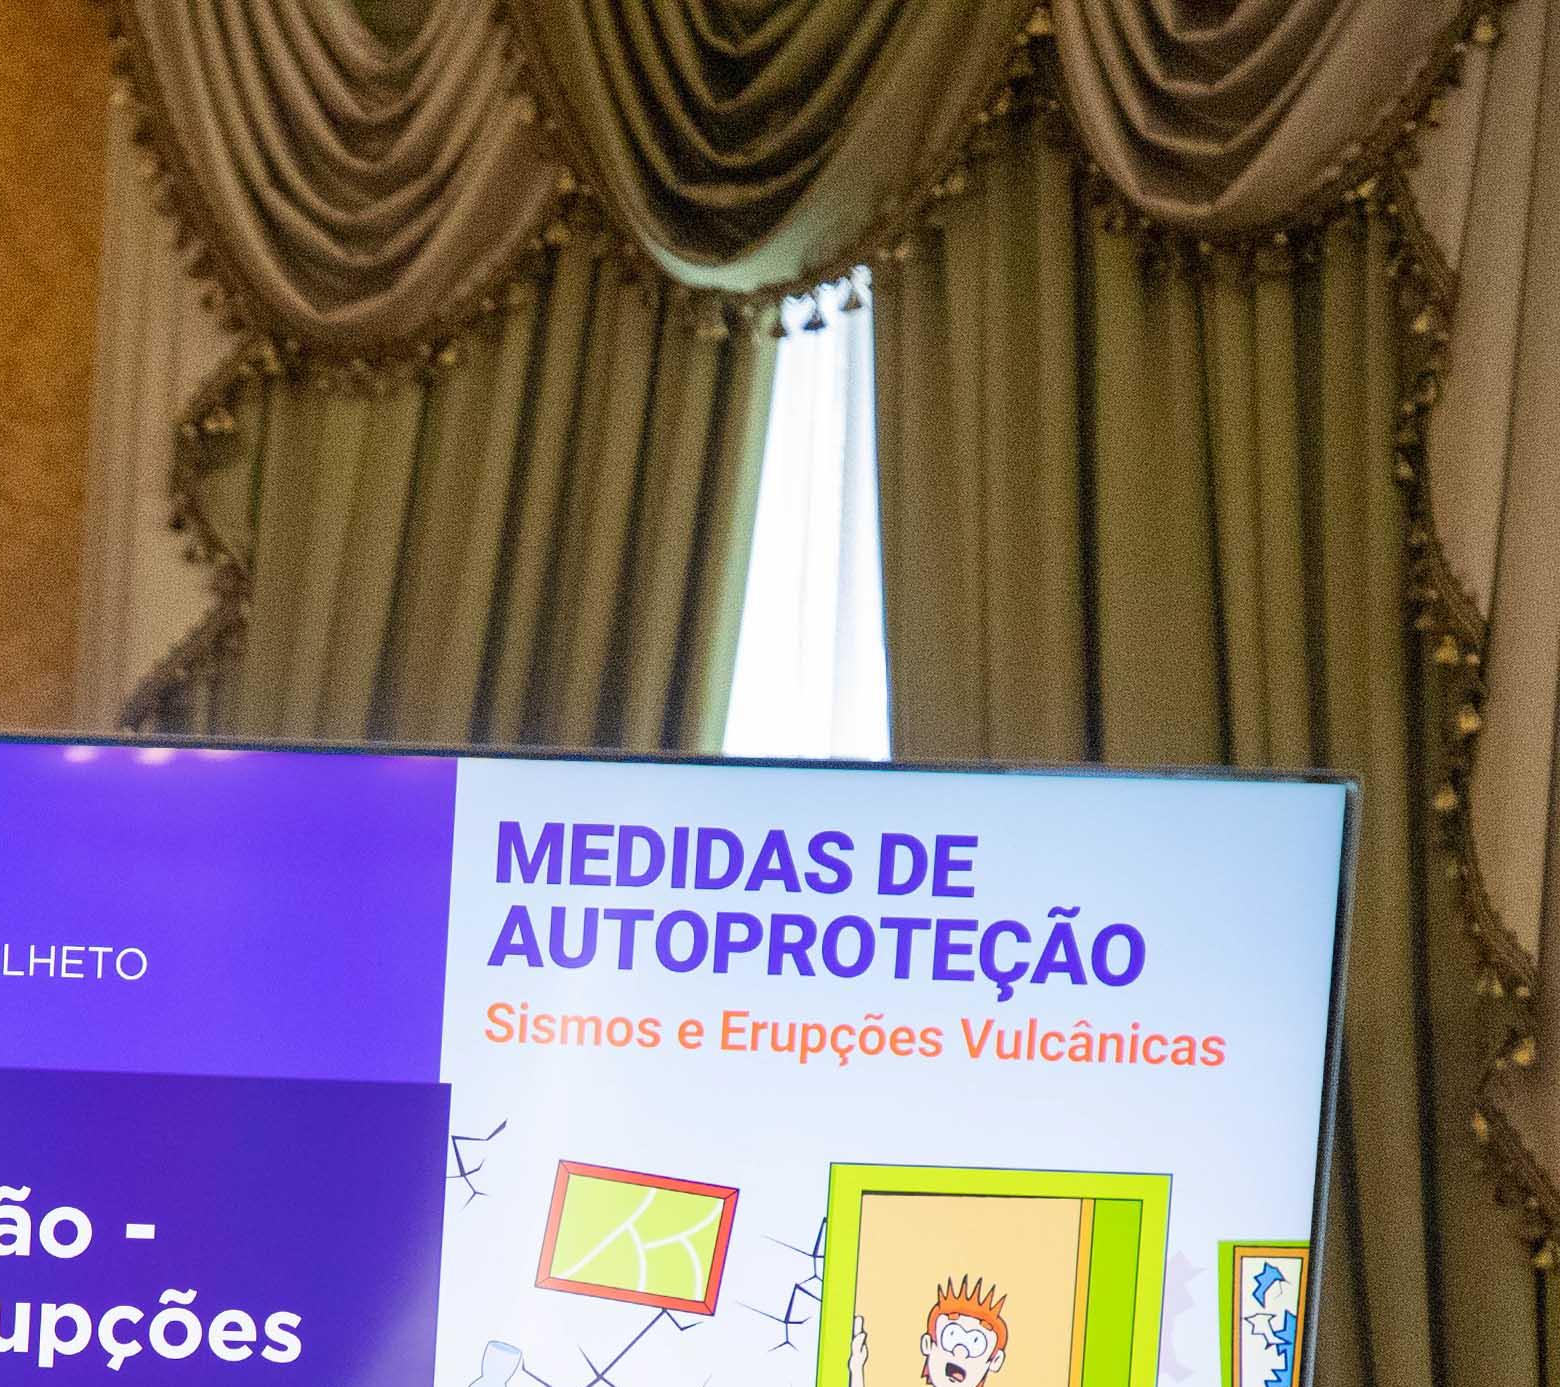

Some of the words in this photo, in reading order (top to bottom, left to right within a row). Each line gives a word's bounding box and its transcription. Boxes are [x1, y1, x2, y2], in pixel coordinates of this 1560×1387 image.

[495, 820, 854, 894] MEDIDAS
[877, 832, 979, 898] DE
[487, 904, 1146, 1002] AUTOPROTEÇÃO
[484, 1002, 662, 1049] Sismos
[677, 1019, 705, 1050] e
[720, 1010, 944, 1067] Erupções
[960, 1017, 1227, 1067] Vulcânicas
